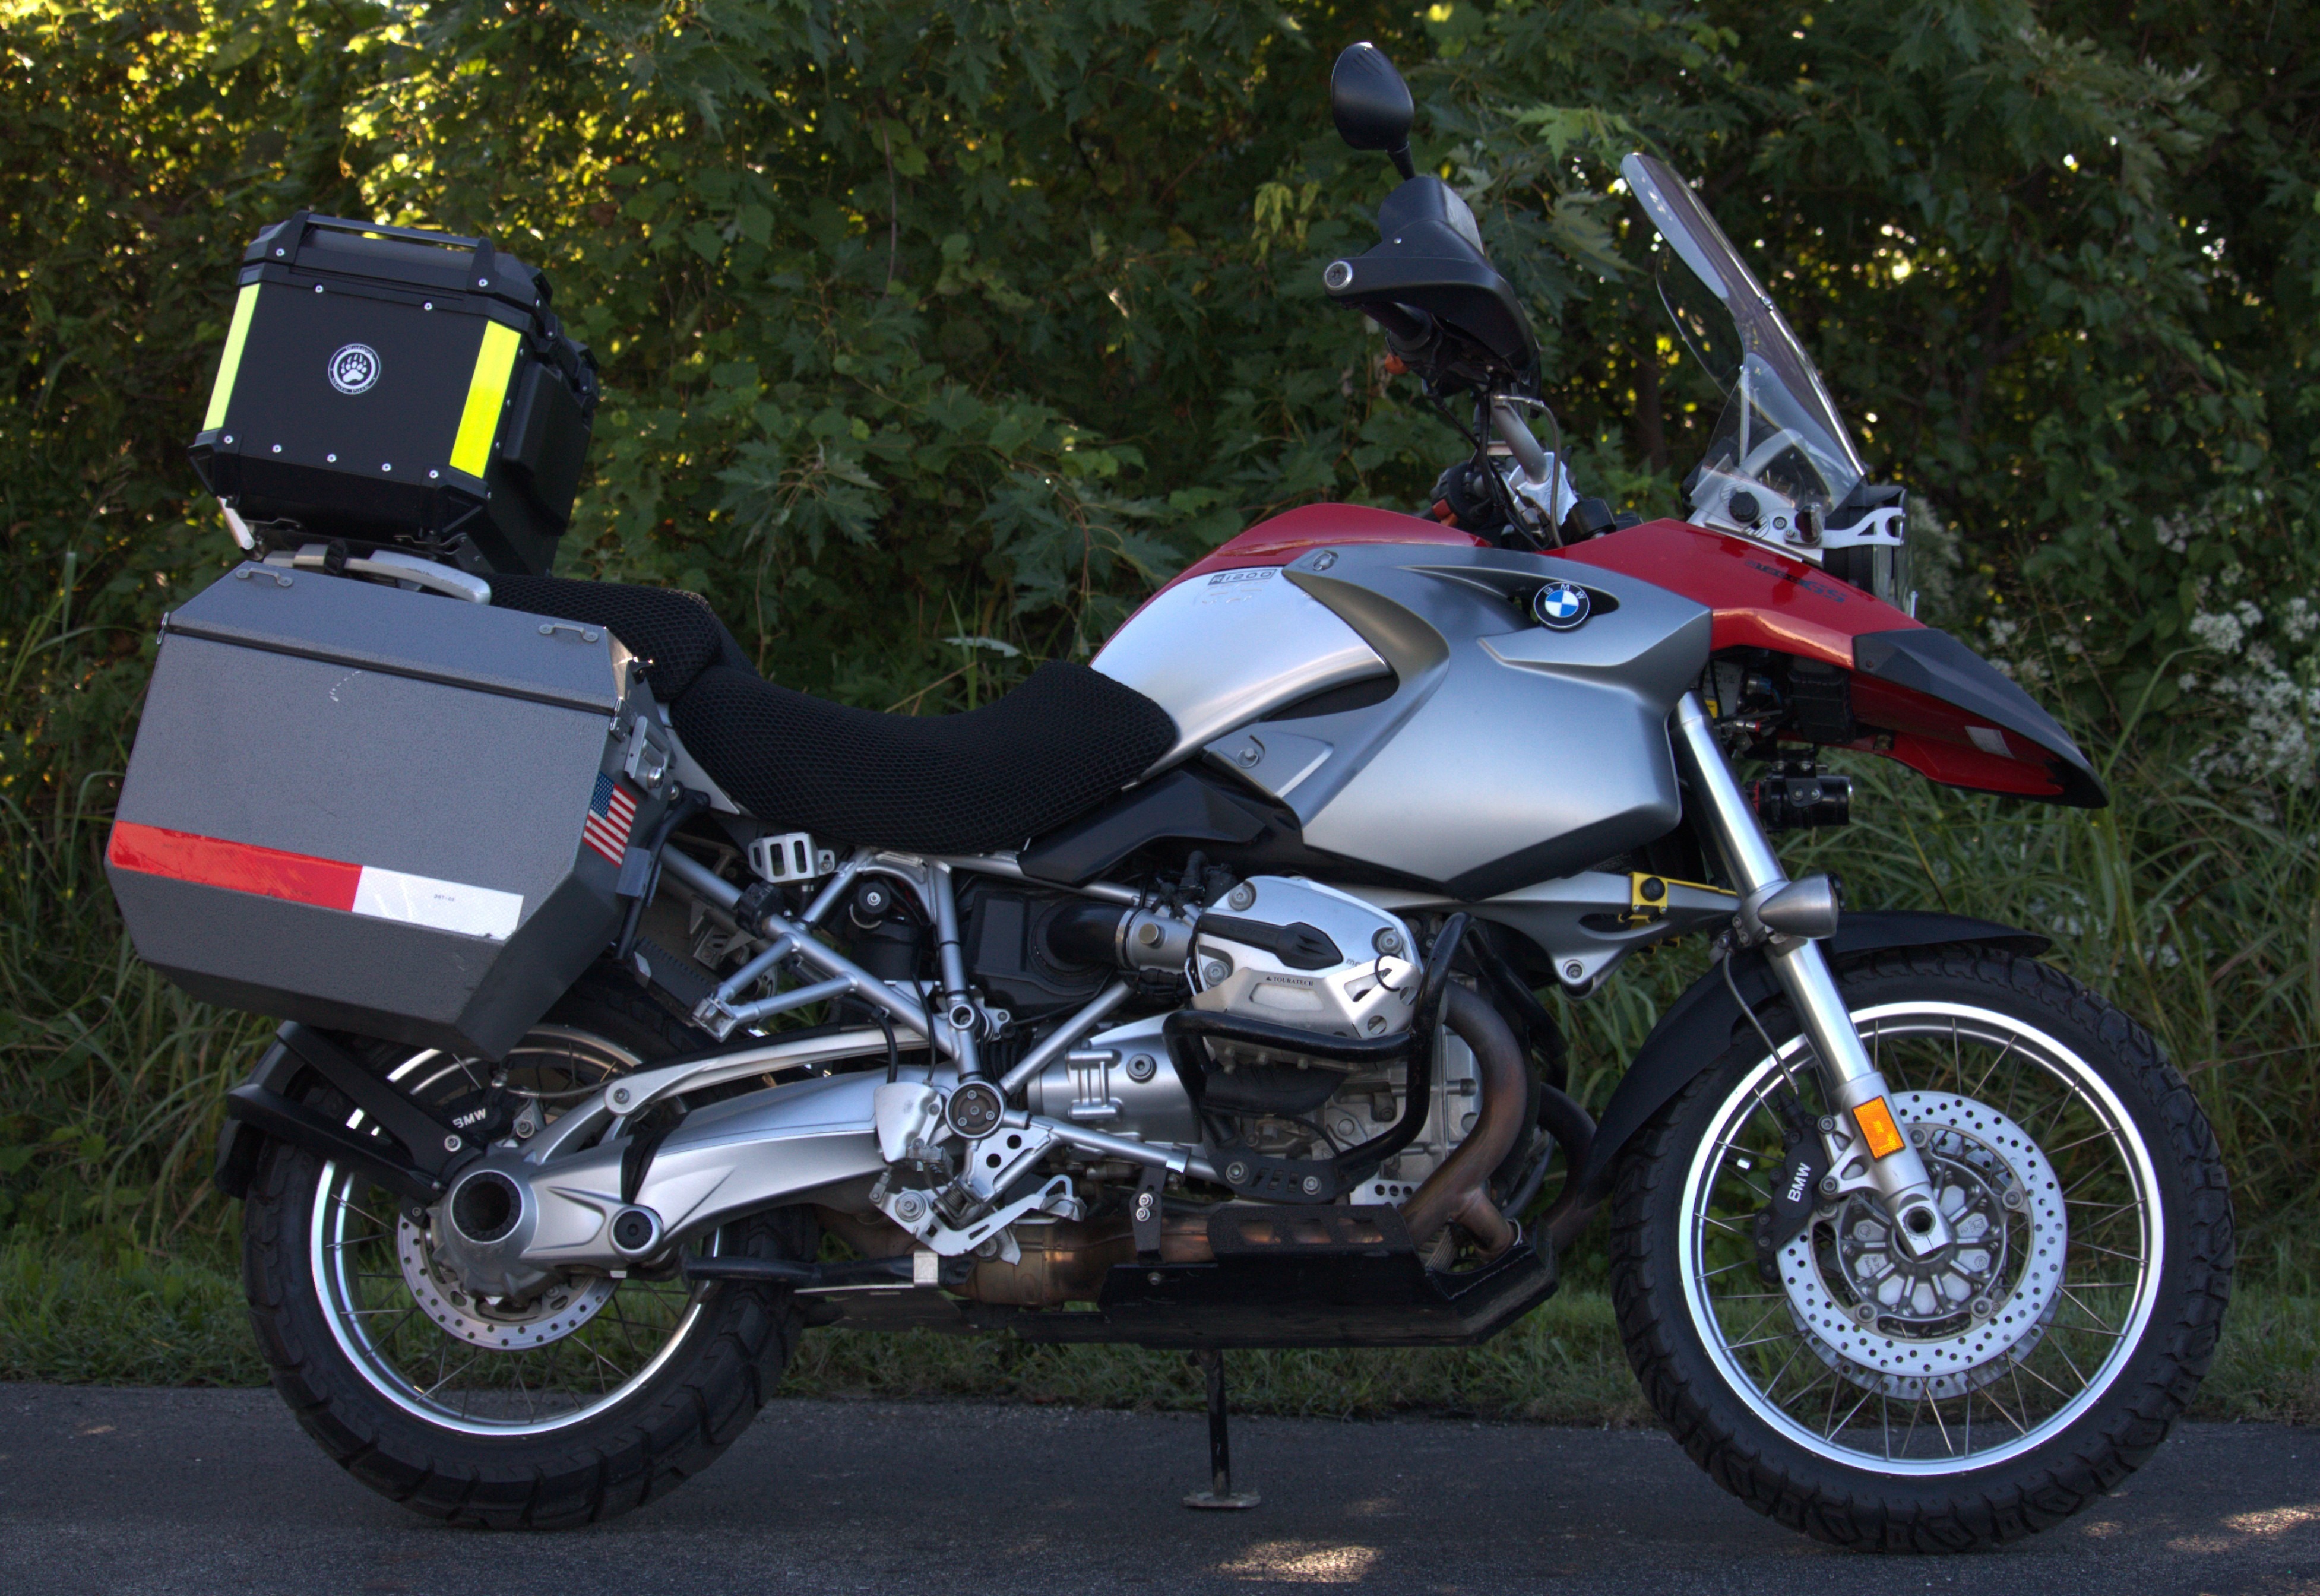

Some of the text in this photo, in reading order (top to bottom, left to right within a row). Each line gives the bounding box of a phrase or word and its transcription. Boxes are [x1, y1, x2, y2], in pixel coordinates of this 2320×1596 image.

[331, 378, 370, 394] State Park
[1210, 570, 1274, 585] R1200
[1543, 583, 1586, 600] BMW
[1273, 976, 1313, 986] TOURATECH
[452, 1107, 487, 1128] BMW
[1787, 1162, 1811, 1203] BMW
